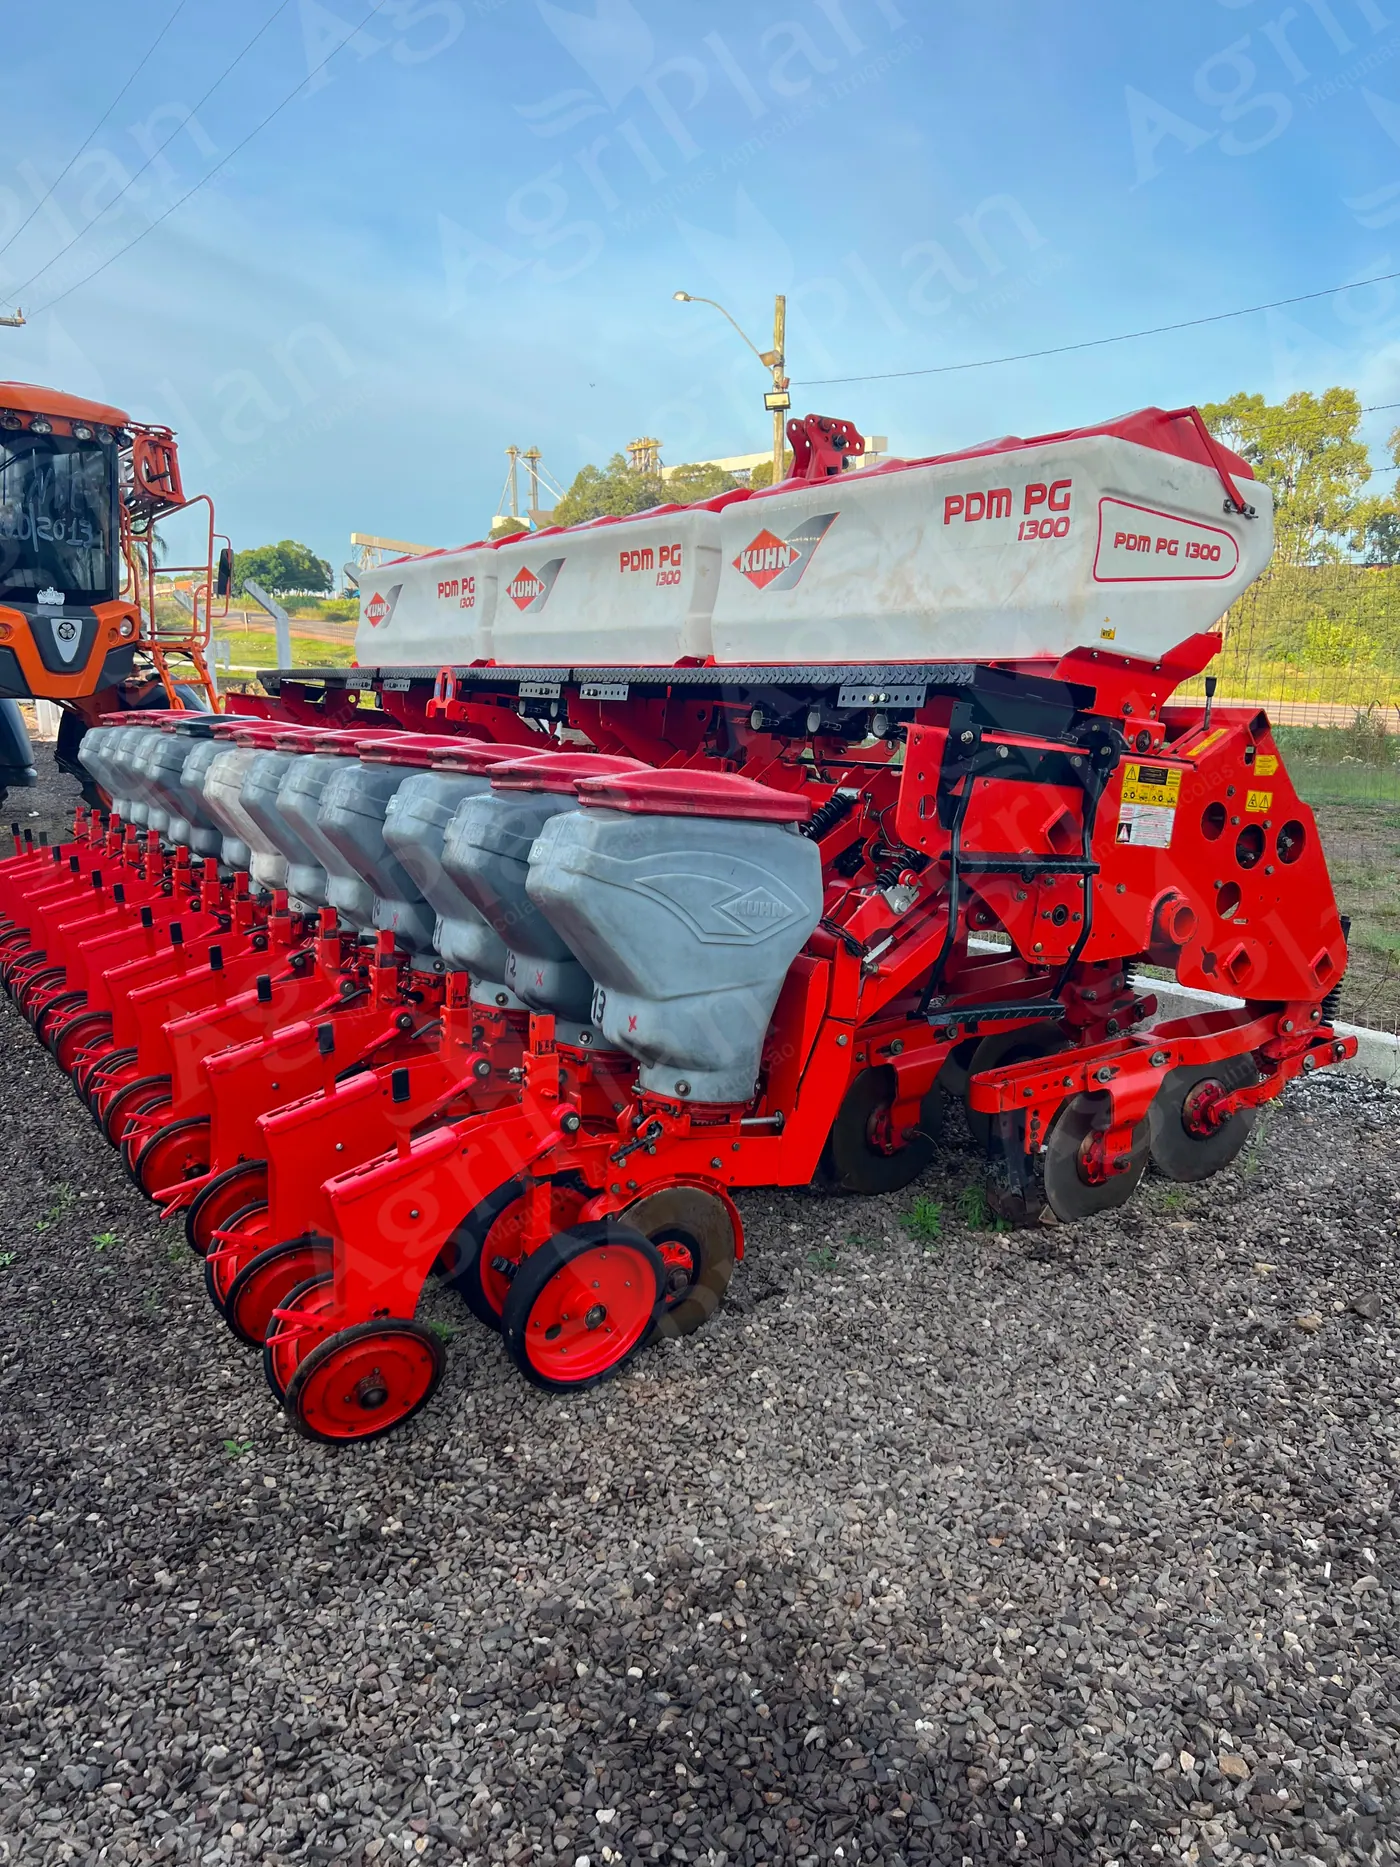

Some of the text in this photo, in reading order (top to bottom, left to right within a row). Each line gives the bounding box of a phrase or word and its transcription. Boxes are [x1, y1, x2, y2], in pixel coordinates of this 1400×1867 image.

[943, 478, 1072, 525] PDM PG
[1017, 516, 1070, 541] 1300
[620, 543, 682, 573] PDM PG
[1113, 531, 1221, 562] PDM PG 1300
[740, 545, 792, 573] KUHN
[437, 576, 475, 599] PDM PG
[510, 580, 540, 599] KUHN
[656, 570, 681, 586] 1300
[366, 602, 388, 618] KUHN
[459, 595, 475, 609] 1300
[735, 899, 785, 919] KUHN
[592, 987, 606, 1023] 13
